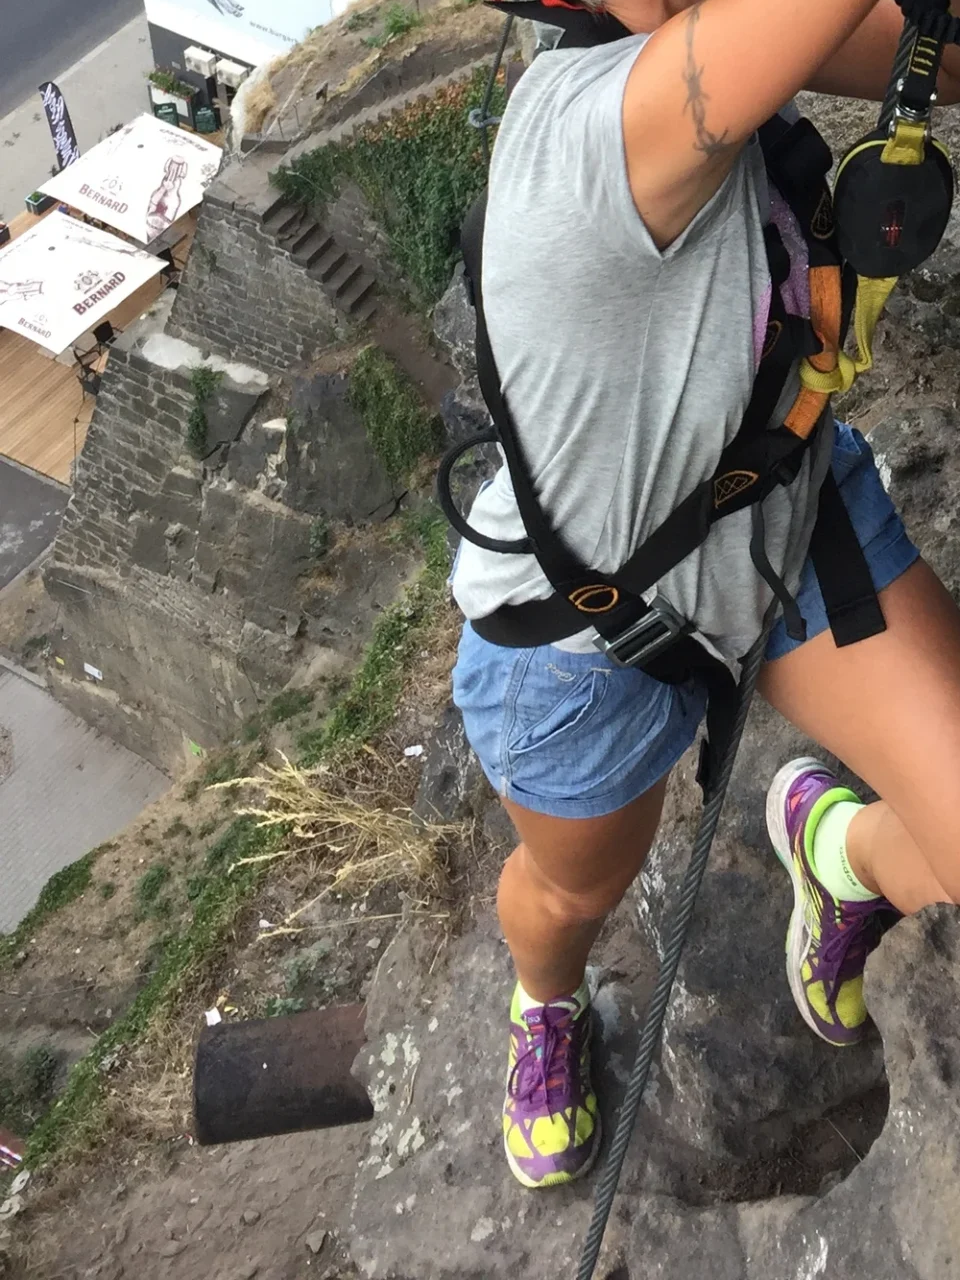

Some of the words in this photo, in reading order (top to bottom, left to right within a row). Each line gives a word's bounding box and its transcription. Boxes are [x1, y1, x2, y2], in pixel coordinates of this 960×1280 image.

[78, 183, 129, 215] BERNARD
[72, 271, 126, 316] BERNARD
[18, 317, 52, 339] BERNARD
